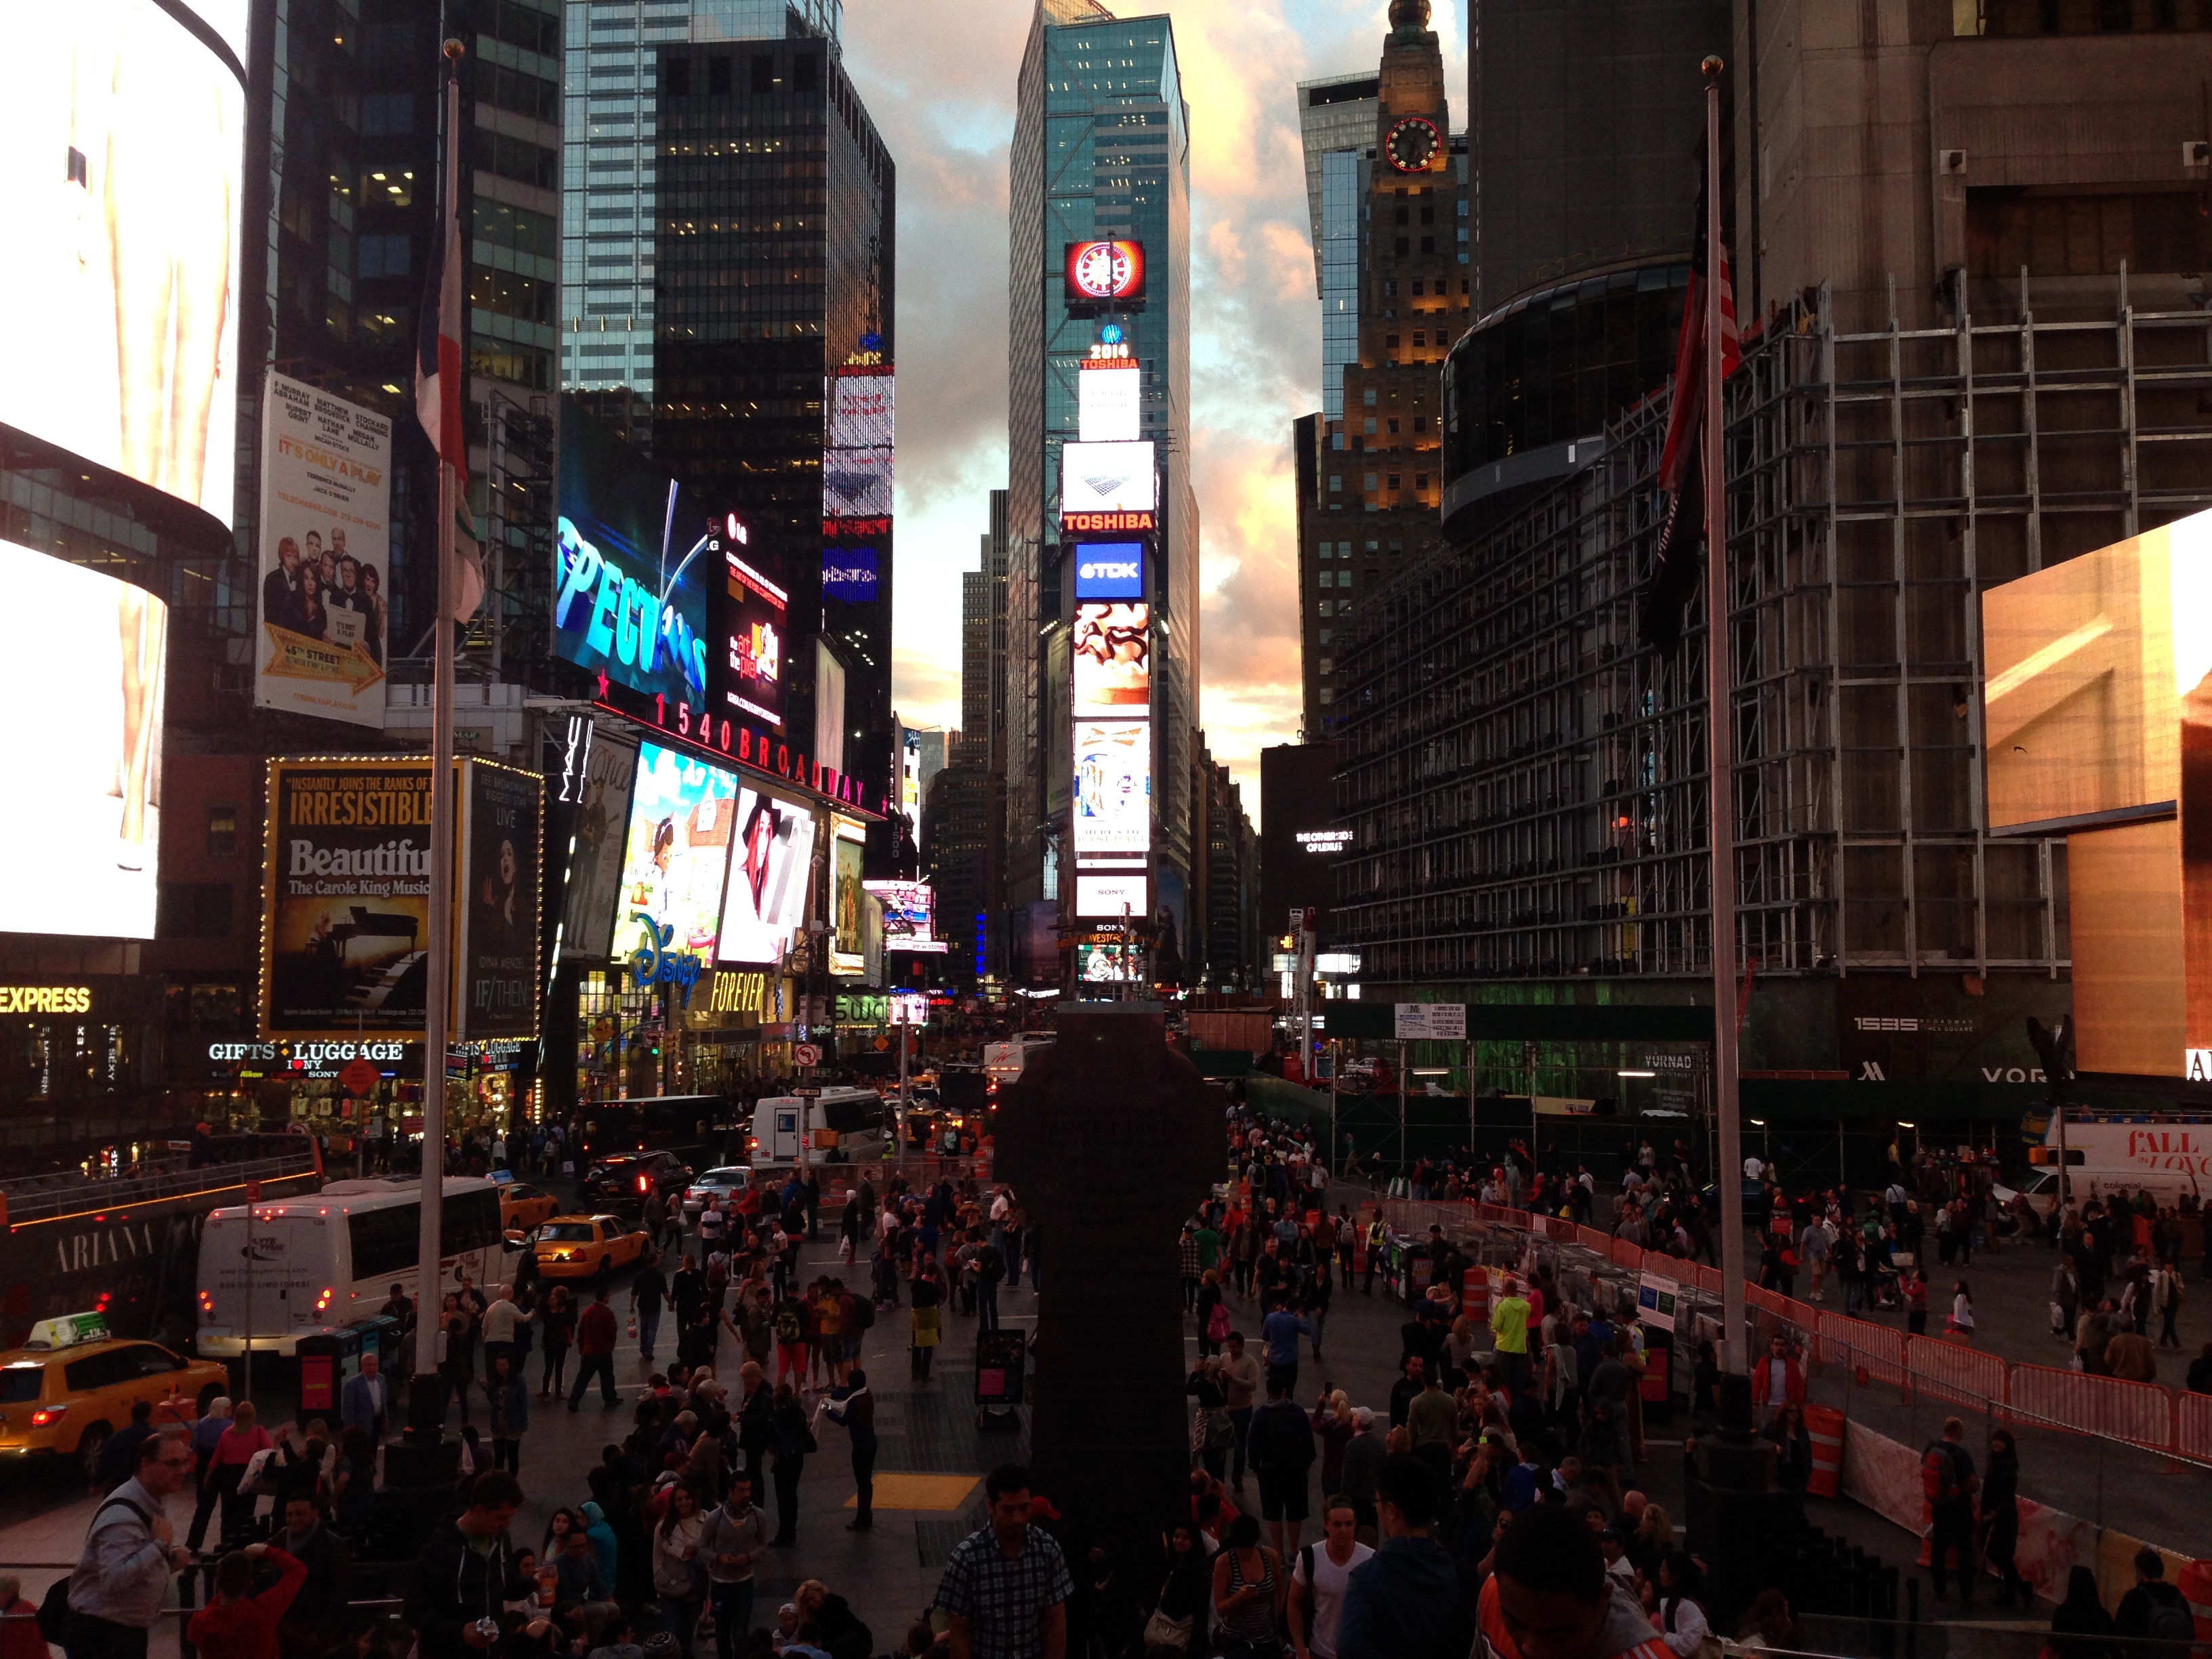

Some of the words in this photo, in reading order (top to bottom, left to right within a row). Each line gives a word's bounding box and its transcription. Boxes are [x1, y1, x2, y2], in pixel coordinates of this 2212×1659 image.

[1090, 344, 1128, 359] 2014
[1082, 359, 1138, 369] TOSHIBA
[274, 388, 310, 407] ABRAHAM
[281, 383, 310, 400] MURRAY
[285, 403, 312, 418] RUPERT
[314, 404, 351, 424] BRODERICK
[316, 398, 349, 415] MATTHEW
[288, 411, 308, 424] GRINT
[318, 415, 344, 430] NATHAN
[355, 413, 389, 431] STOCKARD
[323, 424, 340, 436] LANE
[305, 449, 337, 470] ONLY
[340, 462, 348, 476] A
[350, 465, 382, 487] PLAY
[314, 486, 327, 495] JACK
[1064, 514, 1153, 530] TOSHIBA
[1092, 562, 1139, 579] TDK
[306, 649, 342, 665] STREET
[655, 693, 731, 752] 1540
[740, 728, 865, 805] BROADWAY
[338, 777, 365, 791] JOINS
[366, 777, 382, 791] THE
[384, 777, 413, 791] RANKS
[415, 777, 429, 791] OF
[290, 791, 432, 825] IRRESISTIBLE
[496, 806, 516, 828] LIVE
[1317, 842, 1343, 851] LEXUS
[289, 838, 432, 876] Beautifu
[289, 880, 312, 895] The
[314, 880, 357, 895] Carole
[359, 880, 390, 898] King
[392, 880, 430, 895] Music
[474, 975, 528, 1012] IF/THEN
[710, 971, 765, 1012] FOREVER
[0, 987, 89, 1013] EXPRESS
[1854, 1017, 1919, 1031] 1535
[209, 1044, 275, 1061] GIFTS
[293, 1044, 403, 1061] LUGGAGE
[485, 1042, 521, 1054] LUGGAGE
[303, 1060, 323, 1069] NY
[1645, 1054, 1692, 1069] VORNAD
[239, 1069, 265, 1078] Nikon
[2104, 1182, 2141, 1190] colonial
[57, 1222, 154, 1273] ARIANA
